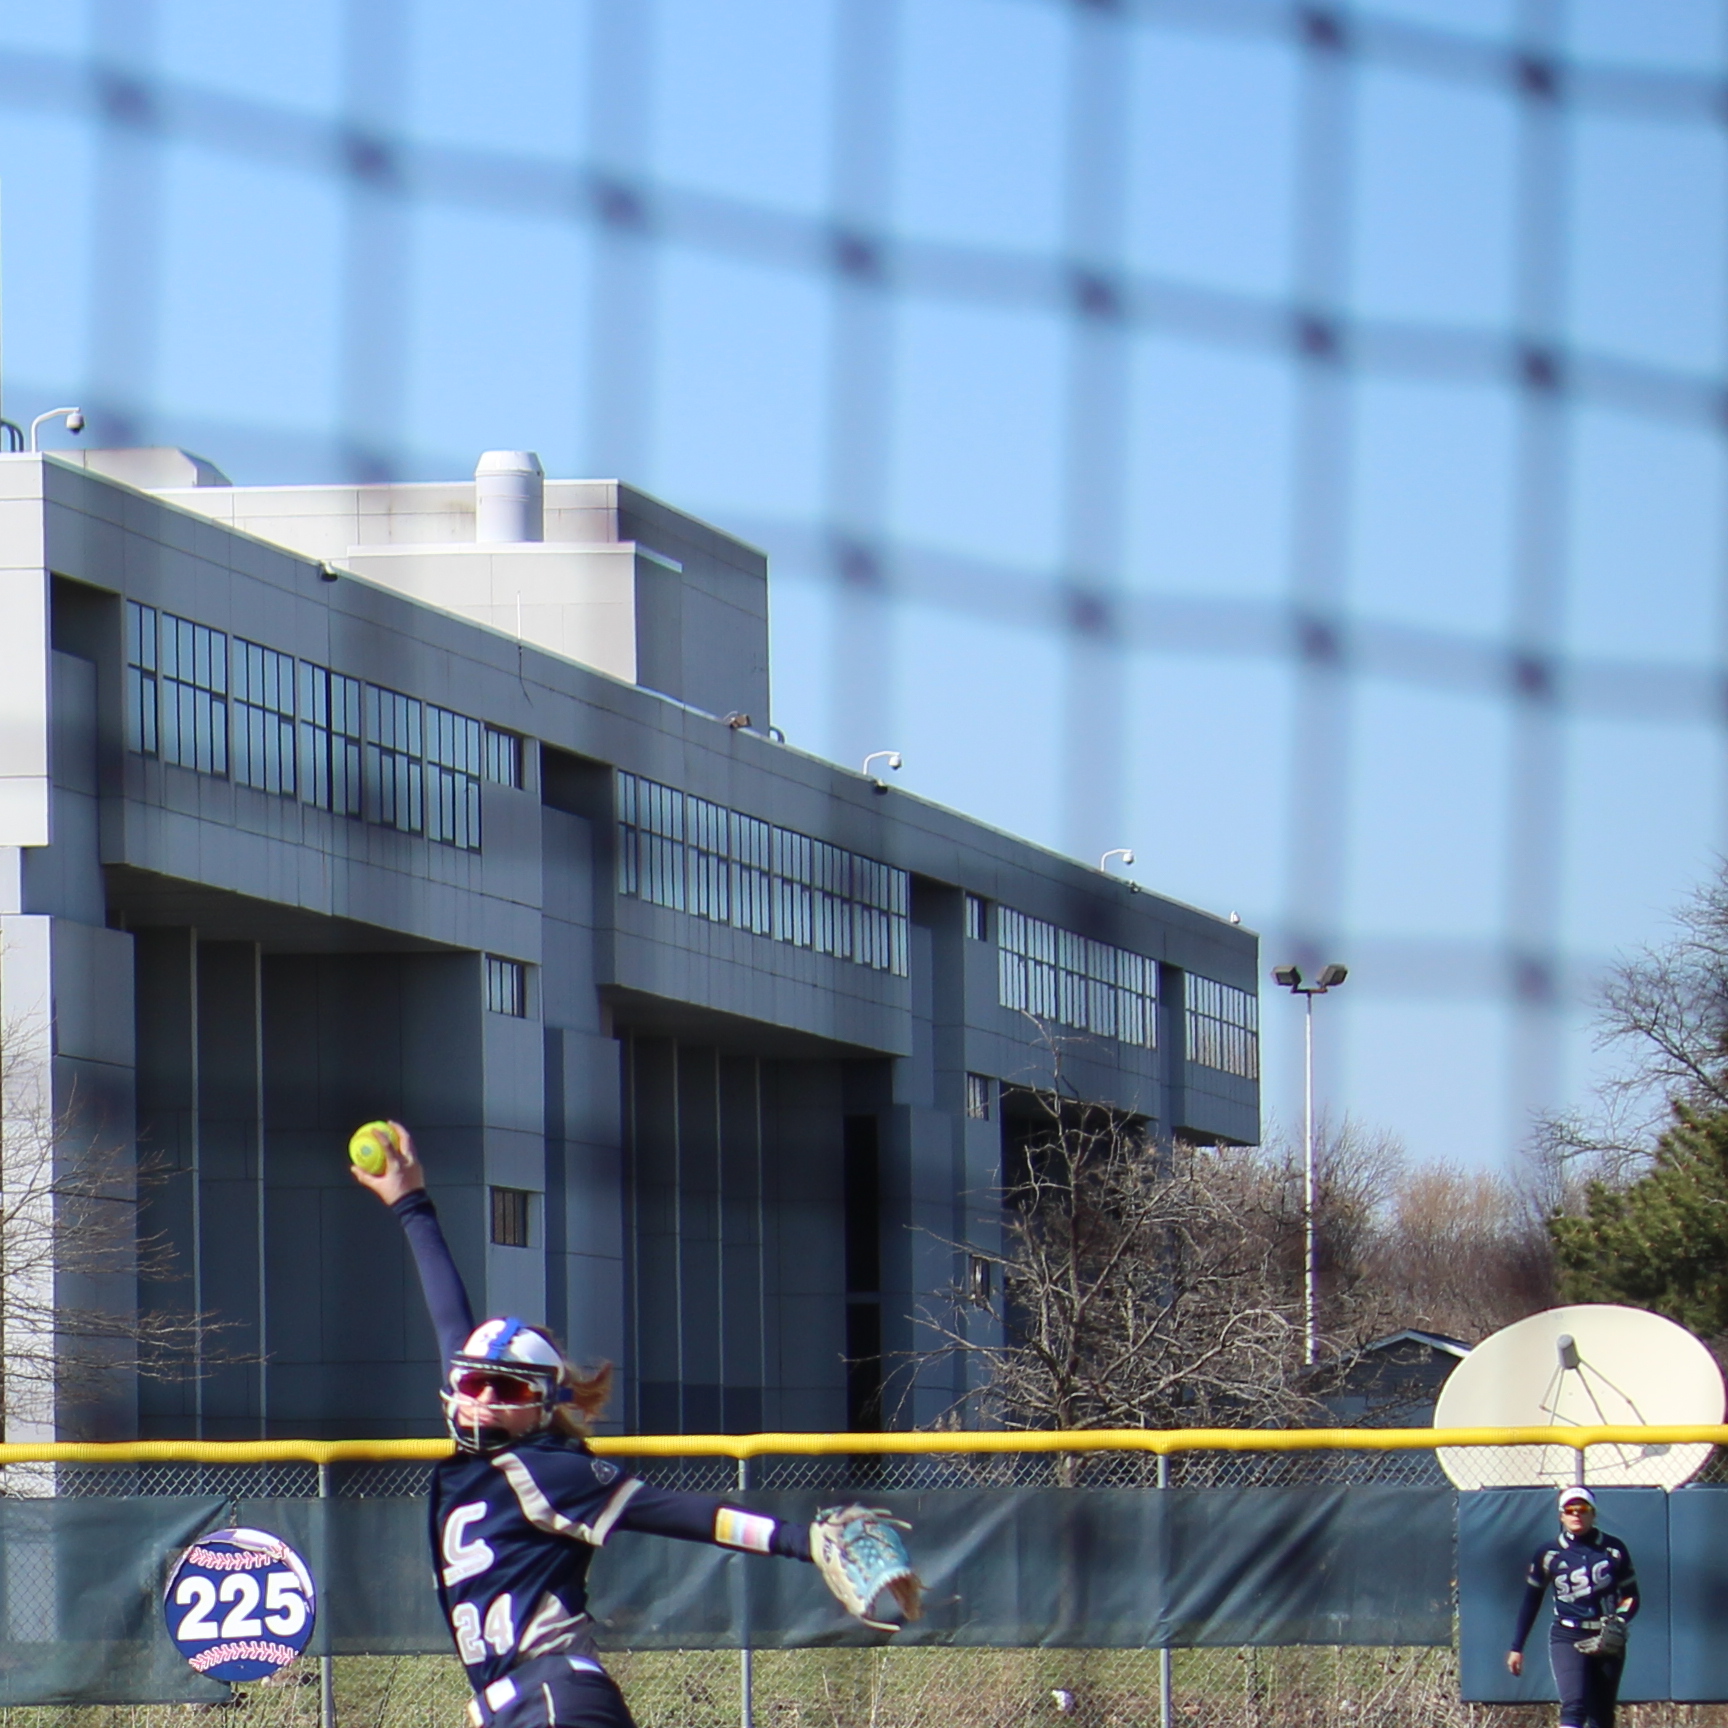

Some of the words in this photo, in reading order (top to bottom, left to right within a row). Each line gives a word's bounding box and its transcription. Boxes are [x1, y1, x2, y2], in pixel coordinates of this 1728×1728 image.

[175, 1572, 307, 1641] 225
[1554, 1560, 1611, 1597] SSC
[452, 1593, 515, 1665] 24
